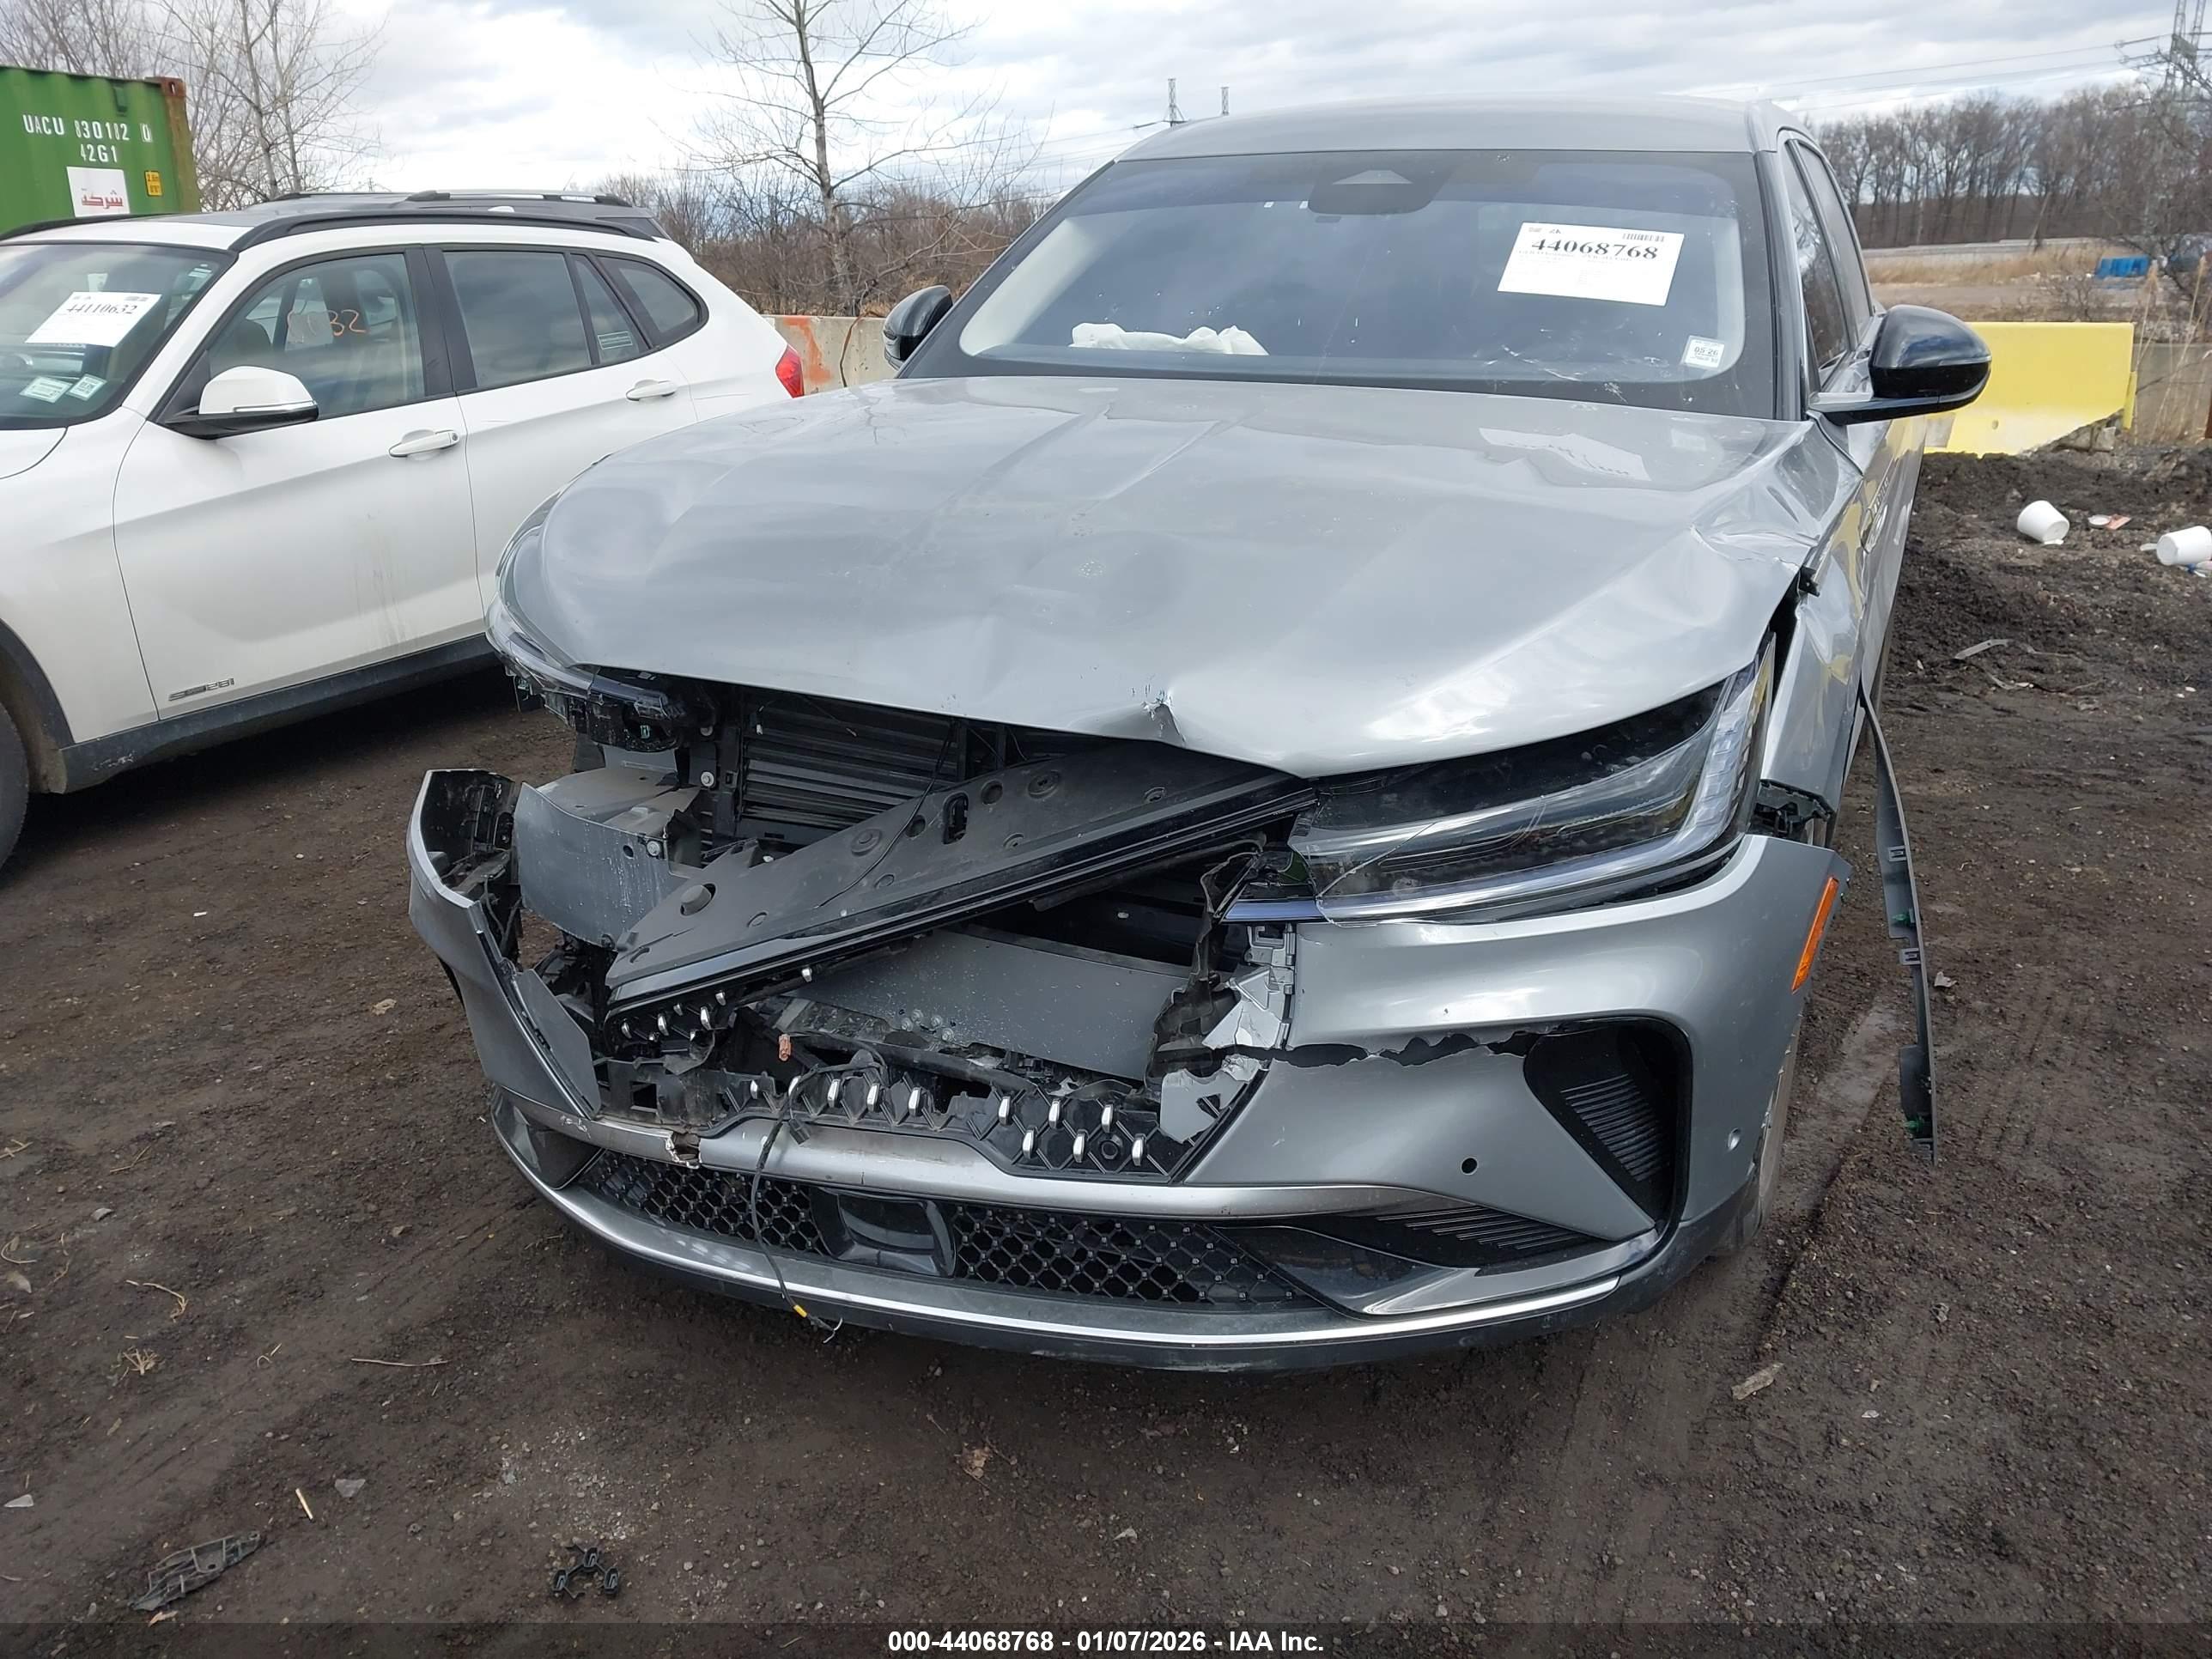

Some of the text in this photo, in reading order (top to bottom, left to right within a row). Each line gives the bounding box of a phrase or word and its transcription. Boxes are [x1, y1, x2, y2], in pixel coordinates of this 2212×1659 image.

[22, 114, 64, 135] UACU
[74, 119, 130, 141] 830182
[80, 143, 118, 163] 42G1
[1531, 239, 1658, 260] 44068768
[66, 303, 138, 314] 44110632
